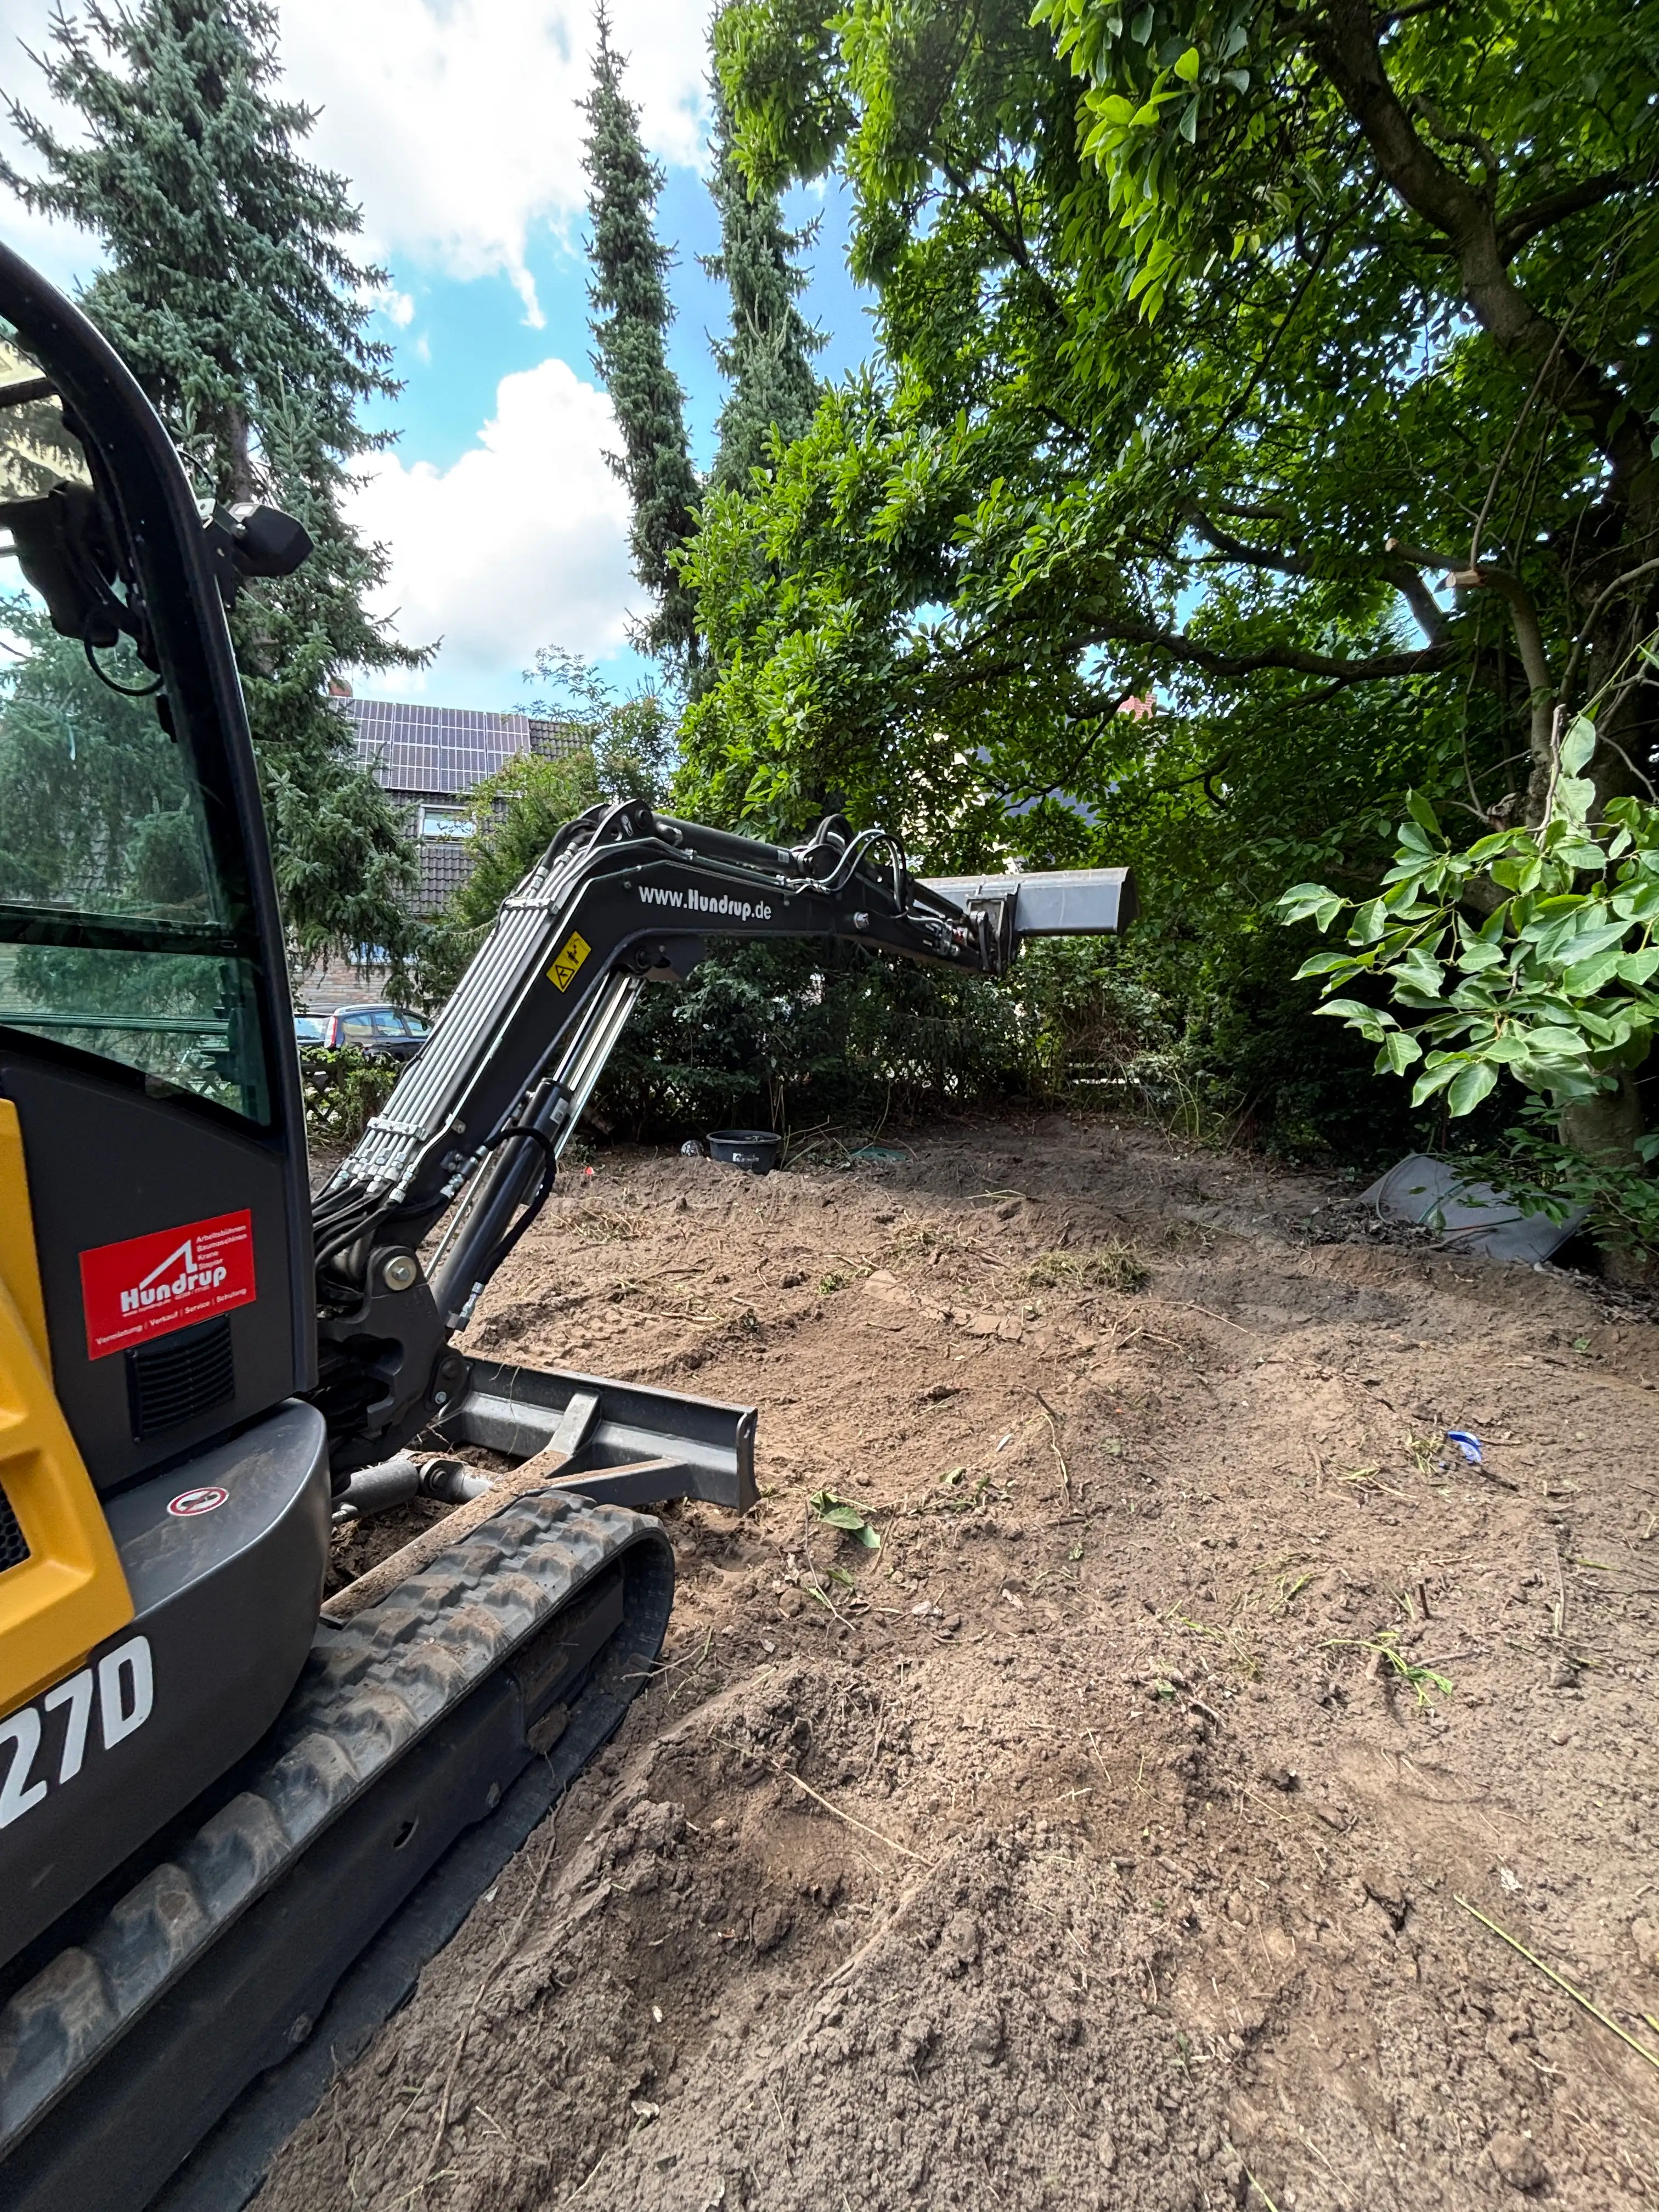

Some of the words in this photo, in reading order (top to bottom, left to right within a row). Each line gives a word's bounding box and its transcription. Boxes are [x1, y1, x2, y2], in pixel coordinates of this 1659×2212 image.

[638, 885, 772, 921] www.Hundrup.de
[120, 1266, 227, 1313] Hundrup
[95, 1324, 143, 1345] Vermietung
[149, 1311, 178, 1326] Verkauf
[184, 1301, 211, 1314] Service
[216, 1288, 247, 1303] Schulung
[0, 1635, 154, 1830] 27D
